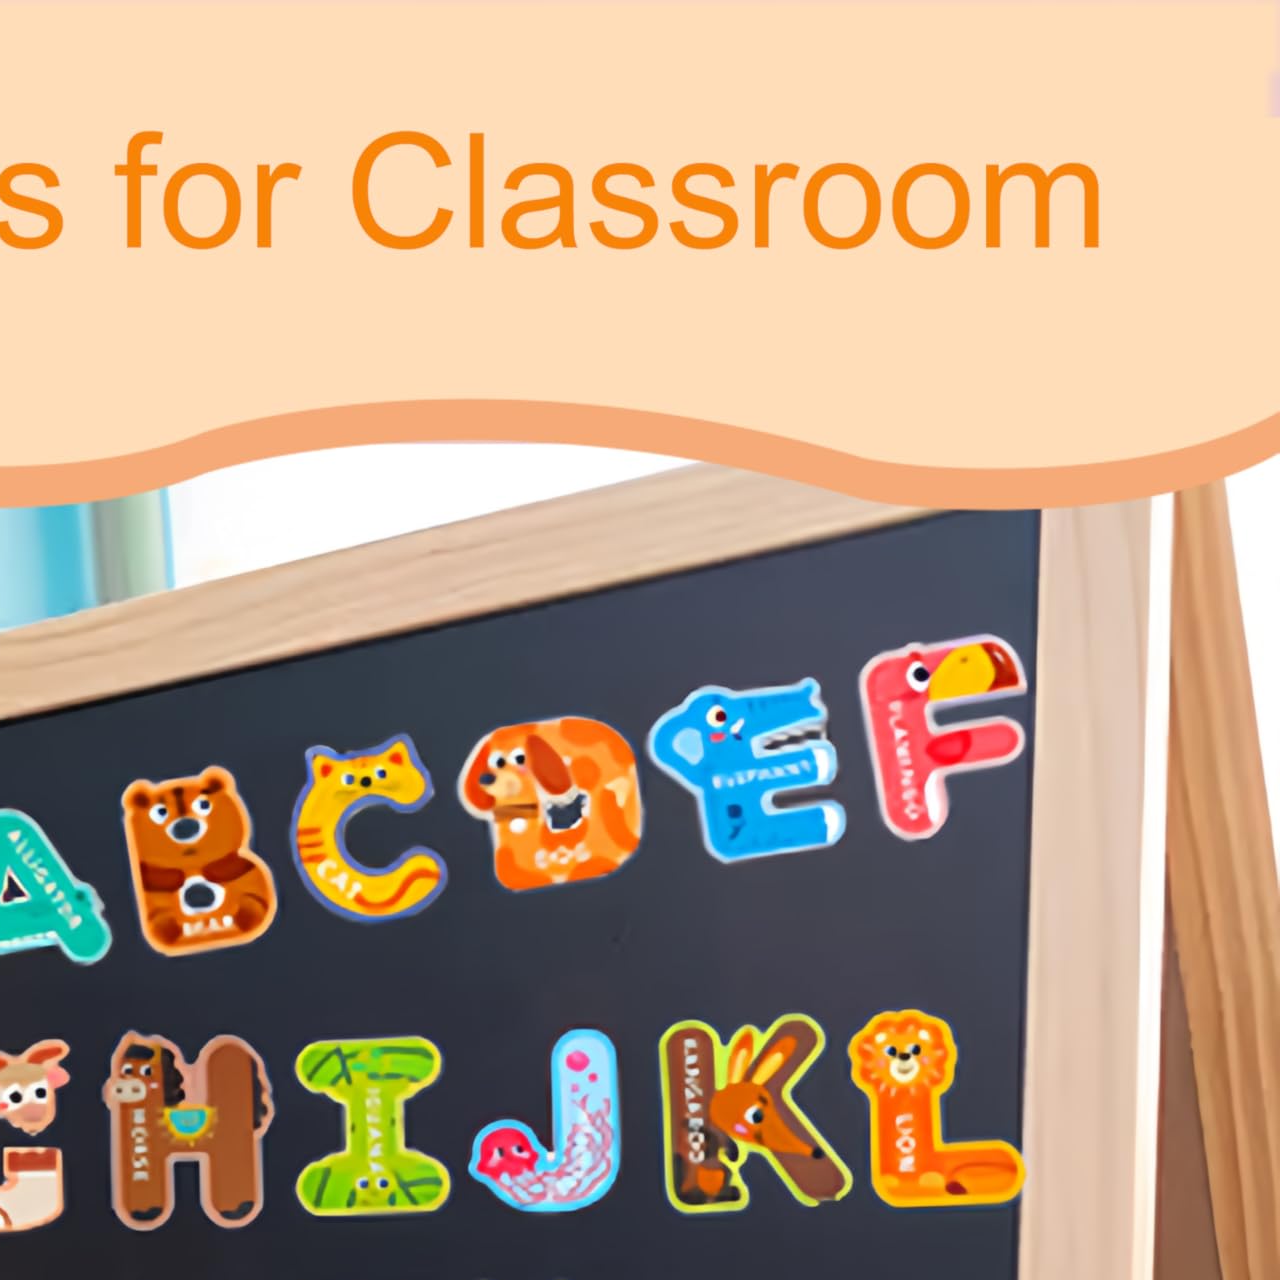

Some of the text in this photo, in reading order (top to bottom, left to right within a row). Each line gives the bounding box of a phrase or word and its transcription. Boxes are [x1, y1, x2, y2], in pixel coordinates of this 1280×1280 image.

[121, 765, 277, 957] B
[290, 733, 448, 923] C
[645, 676, 847, 864] E
[857, 633, 1028, 842] F
[103, 1030, 275, 1231] H
[295, 1036, 451, 1216] I
[468, 1028, 621, 1213] J
[658, 1013, 853, 1216] K
[847, 1009, 1026, 1208] L
